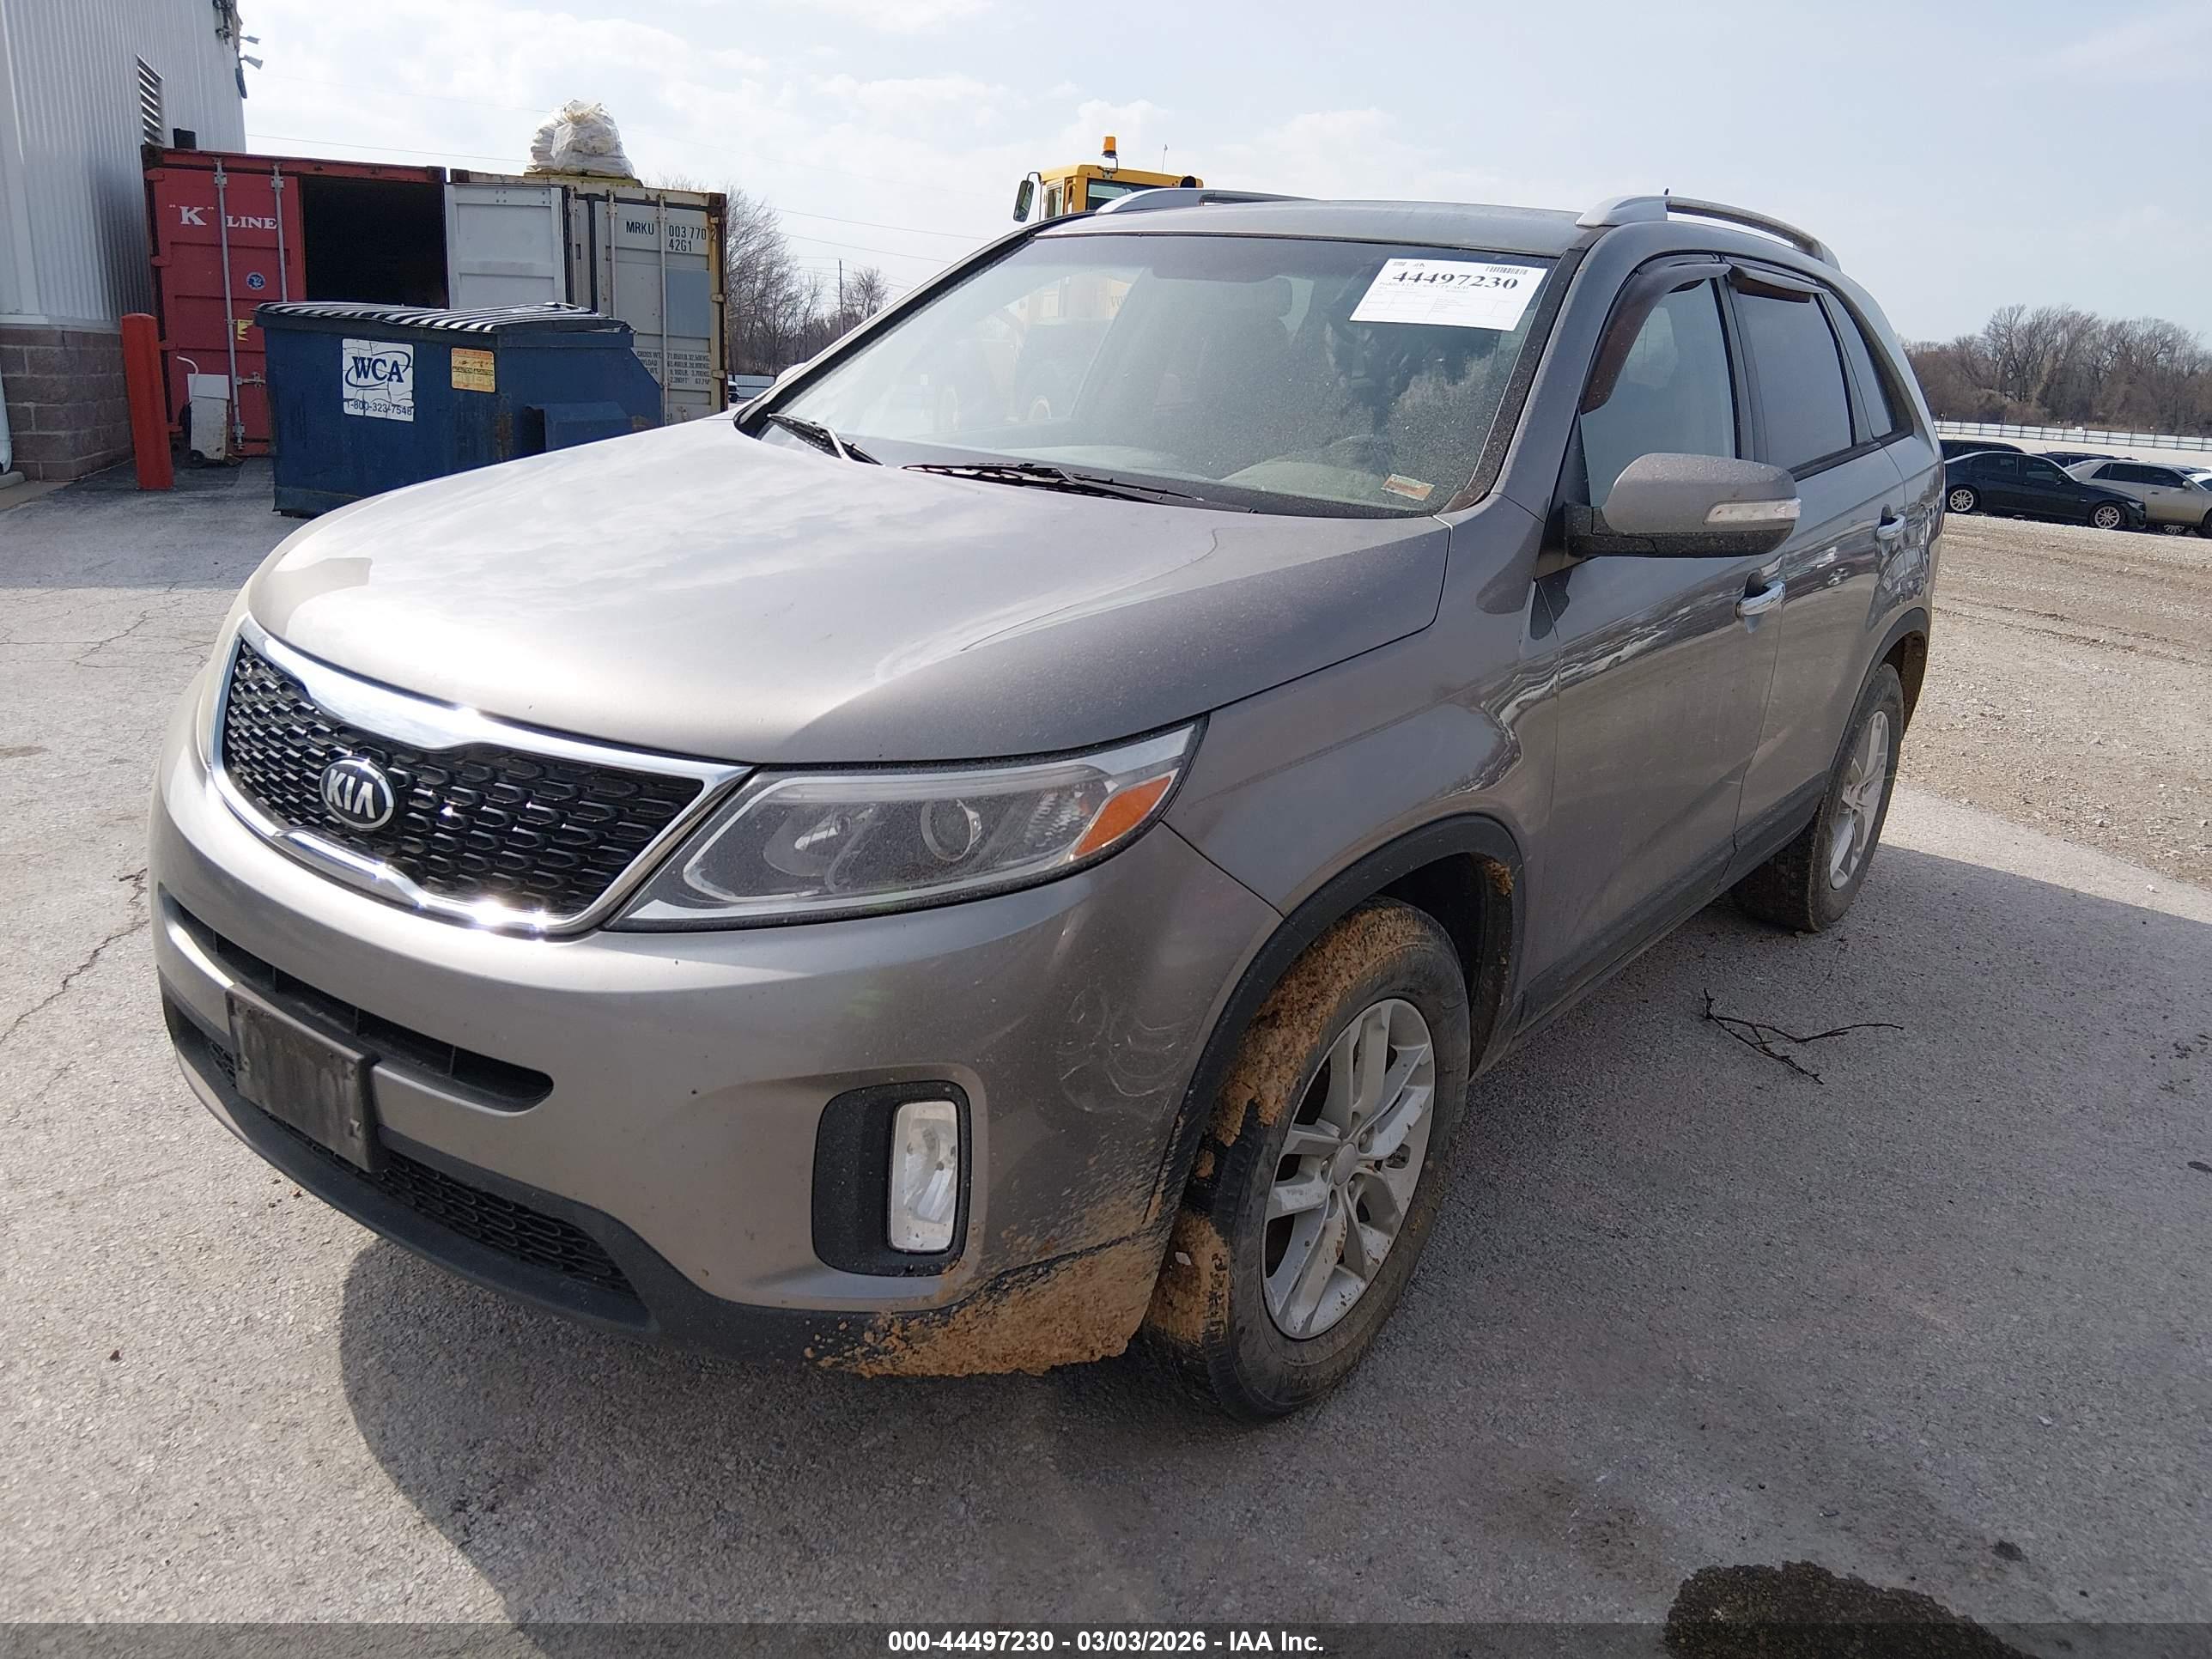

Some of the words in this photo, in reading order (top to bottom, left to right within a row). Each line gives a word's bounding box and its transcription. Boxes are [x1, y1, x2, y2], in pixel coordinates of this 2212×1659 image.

[226, 216, 277, 229] LINE
[626, 221, 654, 234] MRKU
[669, 225, 687, 238] 003
[690, 227, 707, 240] 770
[669, 239, 692, 252] 42G1
[1392, 271, 1518, 290] 44497230
[352, 356, 404, 383] WCA
[346, 400, 412, 416] 1-800-323-7548
[327, 769, 376, 819] KIA
